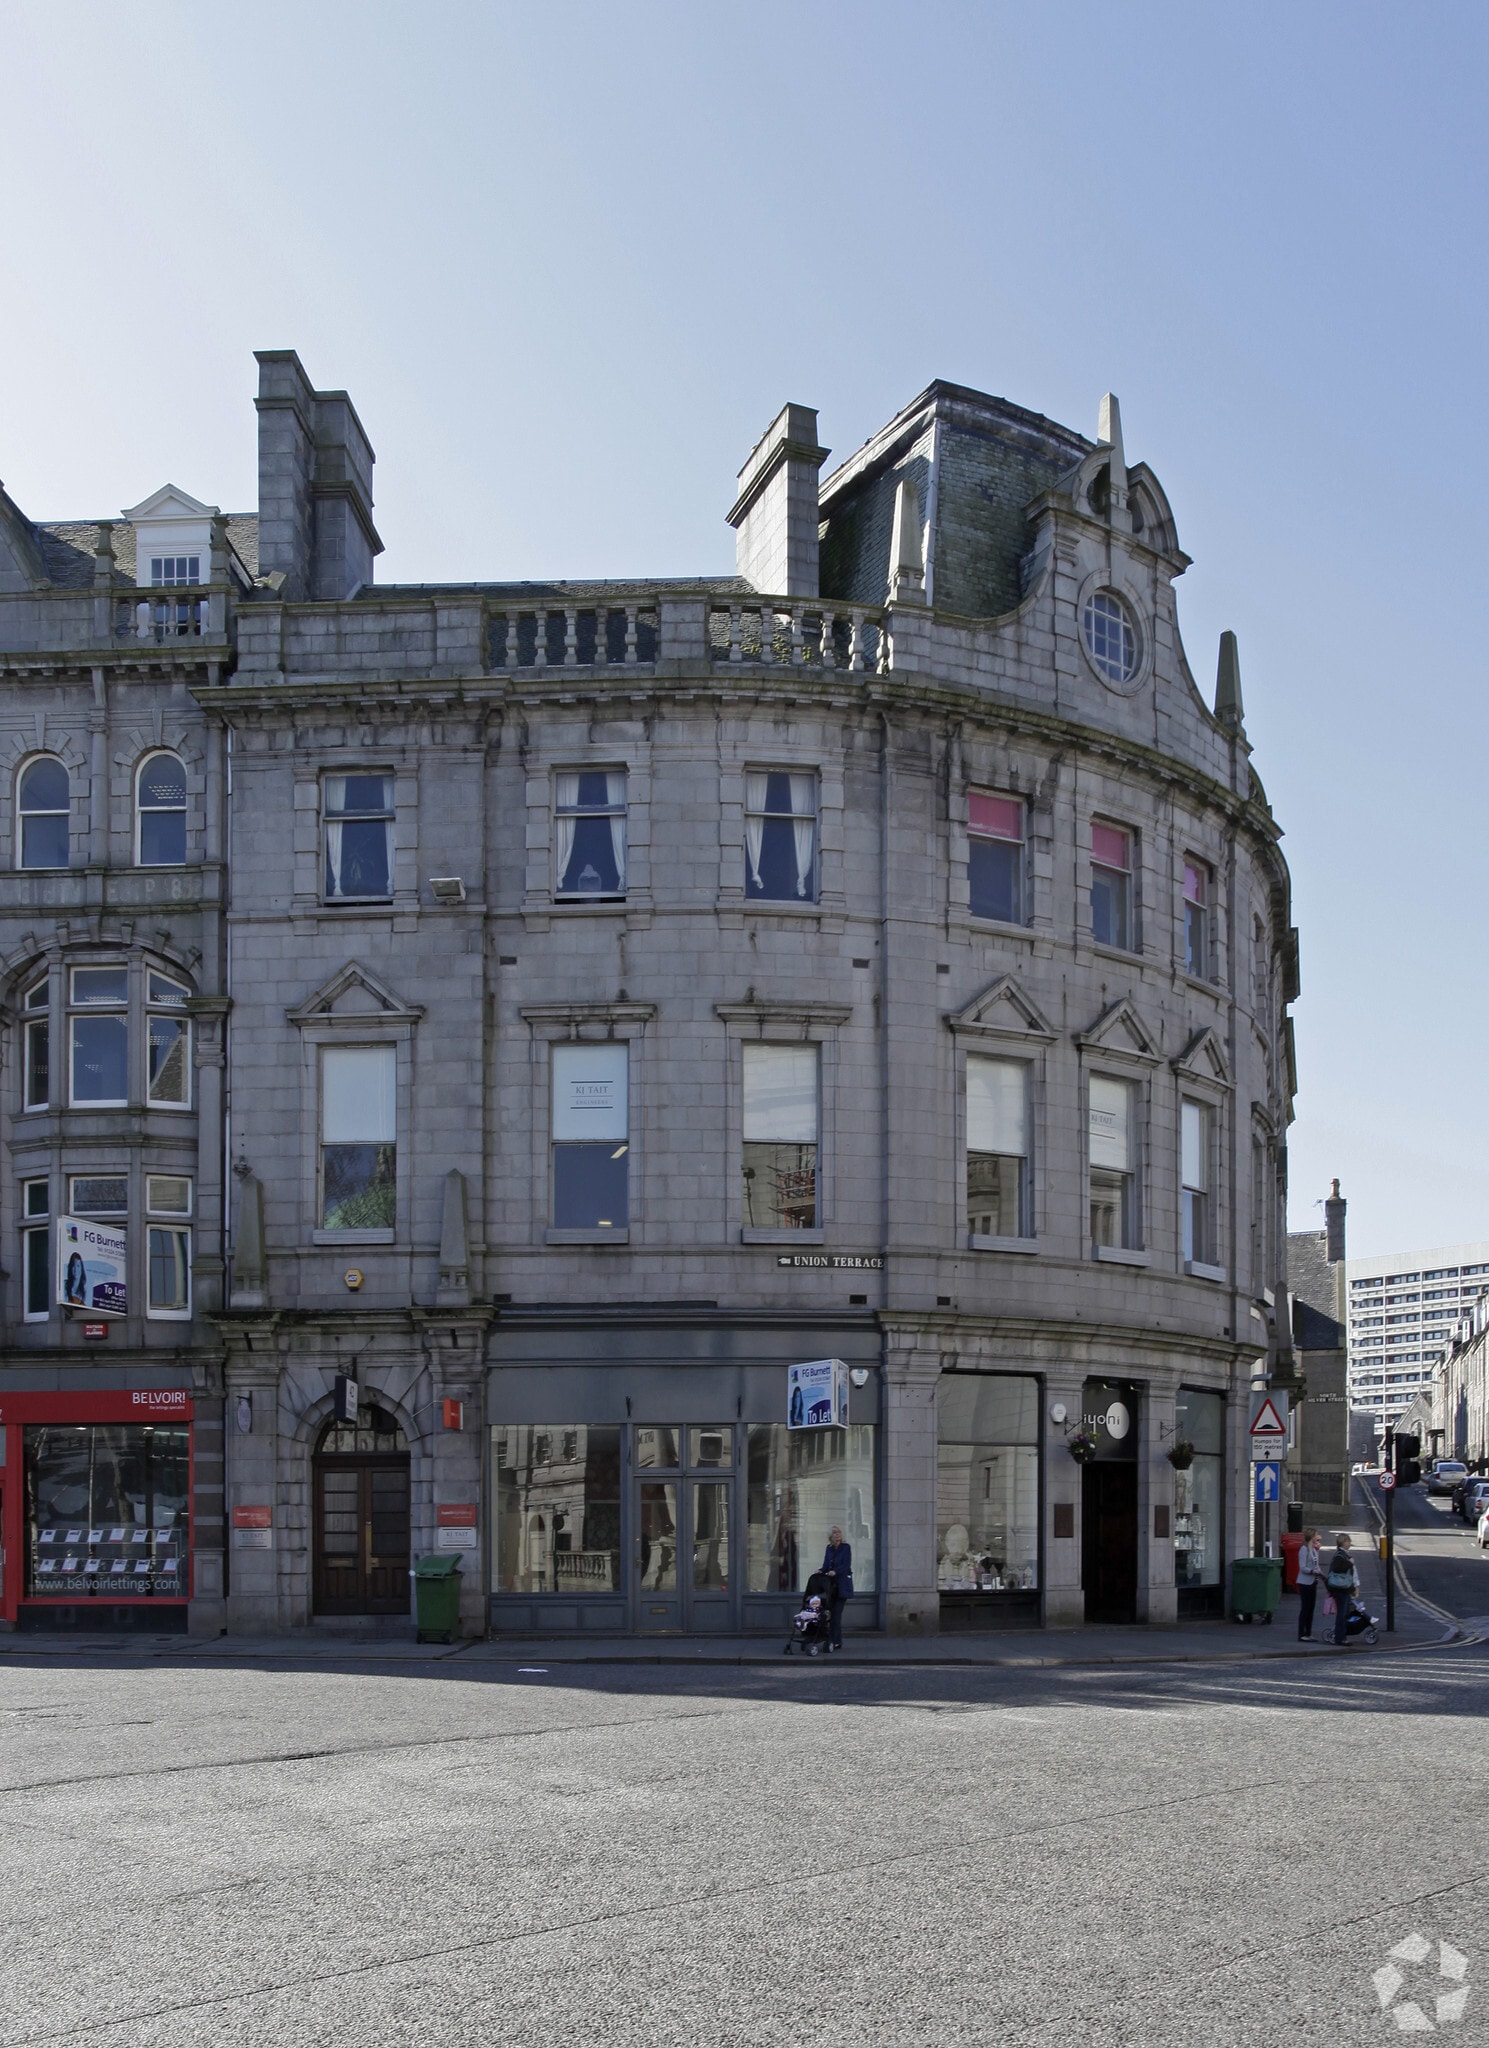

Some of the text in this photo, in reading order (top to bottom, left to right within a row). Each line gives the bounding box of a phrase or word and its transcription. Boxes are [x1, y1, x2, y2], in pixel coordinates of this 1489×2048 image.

[575, 1086, 608, 1094] KJ TAIT
[84, 1230, 127, 1251] FG Burnett
[794, 1256, 883, 1268] UNION TERRACE
[104, 1284, 126, 1297] To Let
[801, 1366, 831, 1378] FG Burnett
[132, 1391, 186, 1404] BELVOIR!
[808, 1409, 832, 1423] To Let
[1083, 1414, 1120, 1434] iyoni
[1381, 1476, 1393, 1485] 20
[36, 1577, 180, 1592] www.belvoirlettingscom
